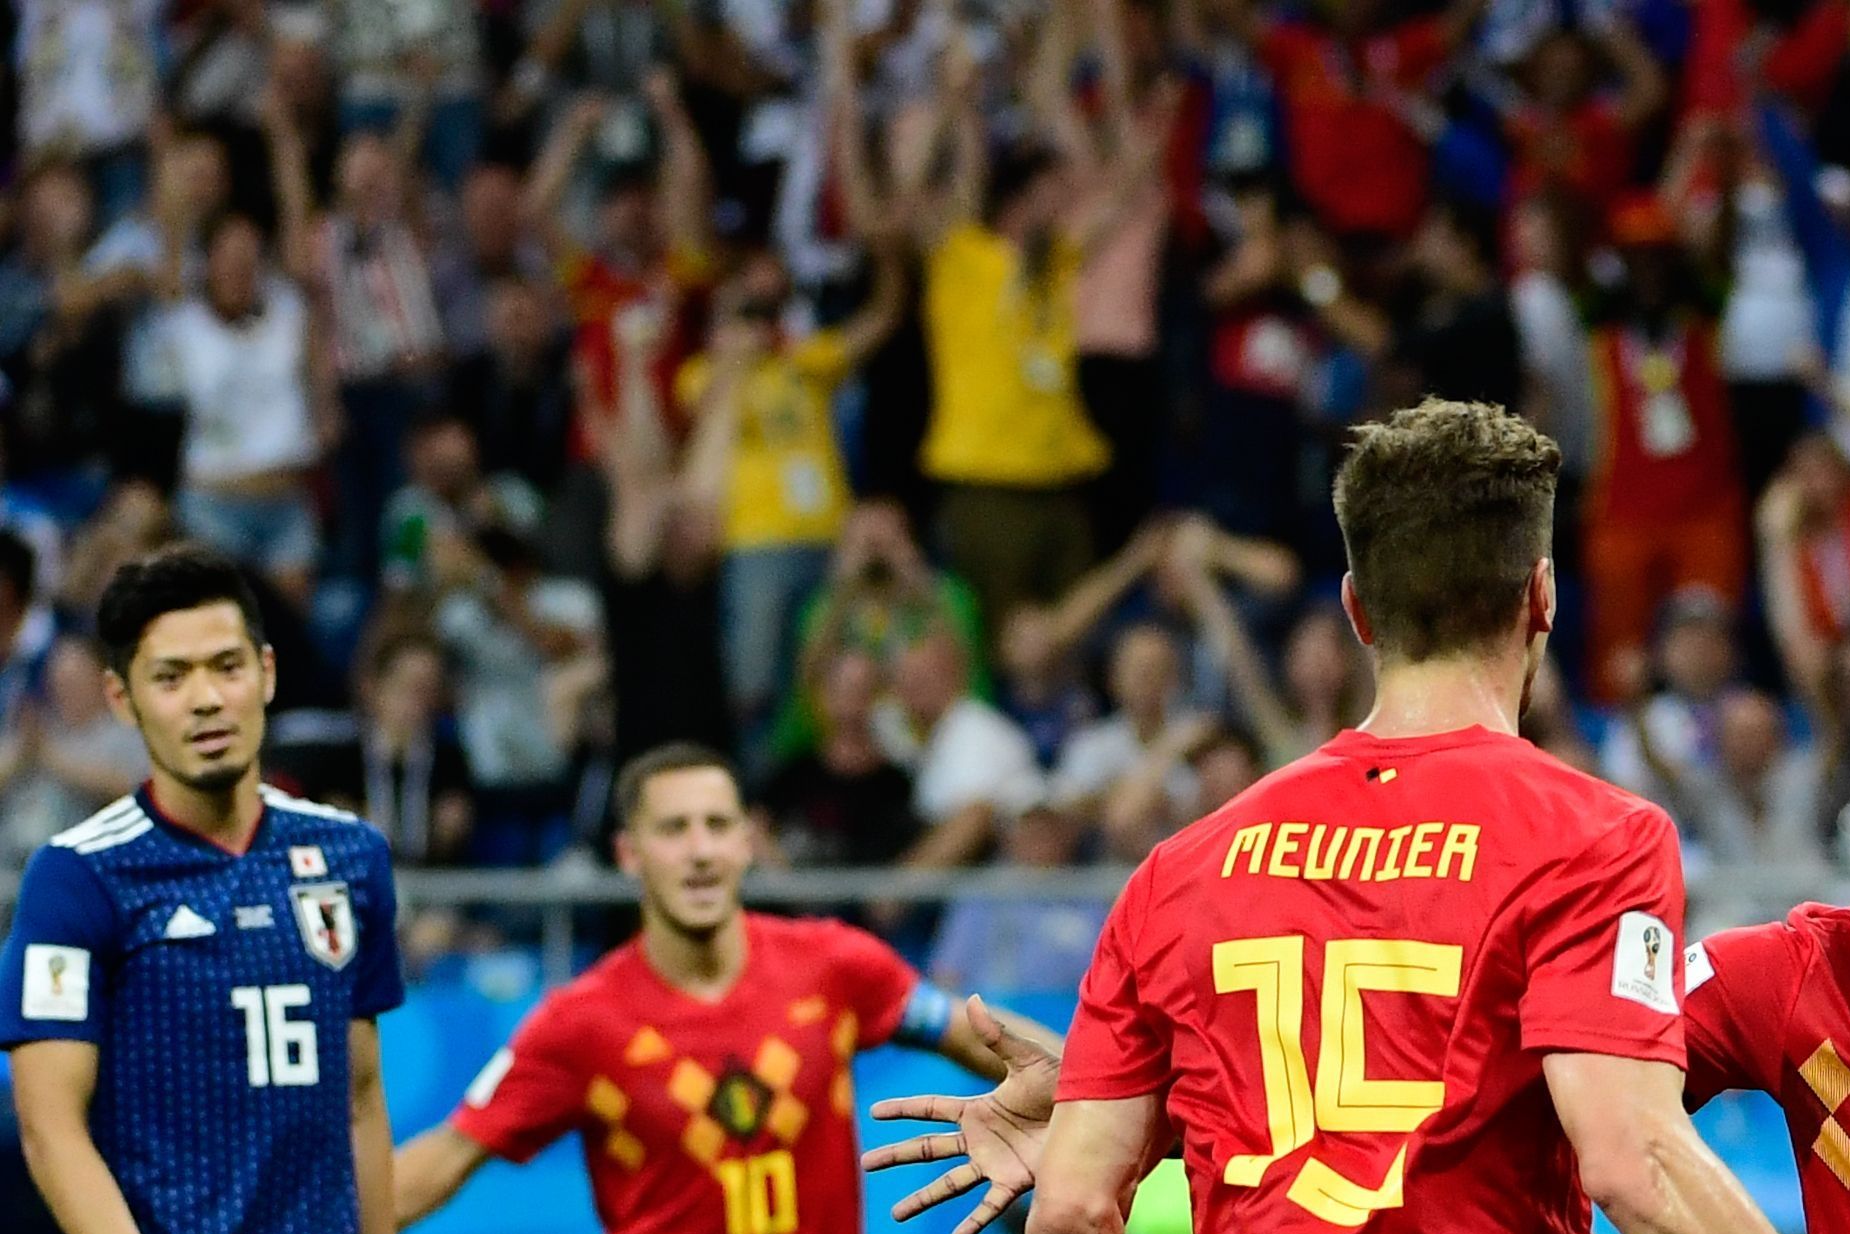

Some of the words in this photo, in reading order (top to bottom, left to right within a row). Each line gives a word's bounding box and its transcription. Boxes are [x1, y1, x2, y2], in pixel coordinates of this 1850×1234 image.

[1221, 822, 1481, 882] MEUNIER
[231, 984, 319, 1087] 16
[1212, 935, 1463, 1227] 15
